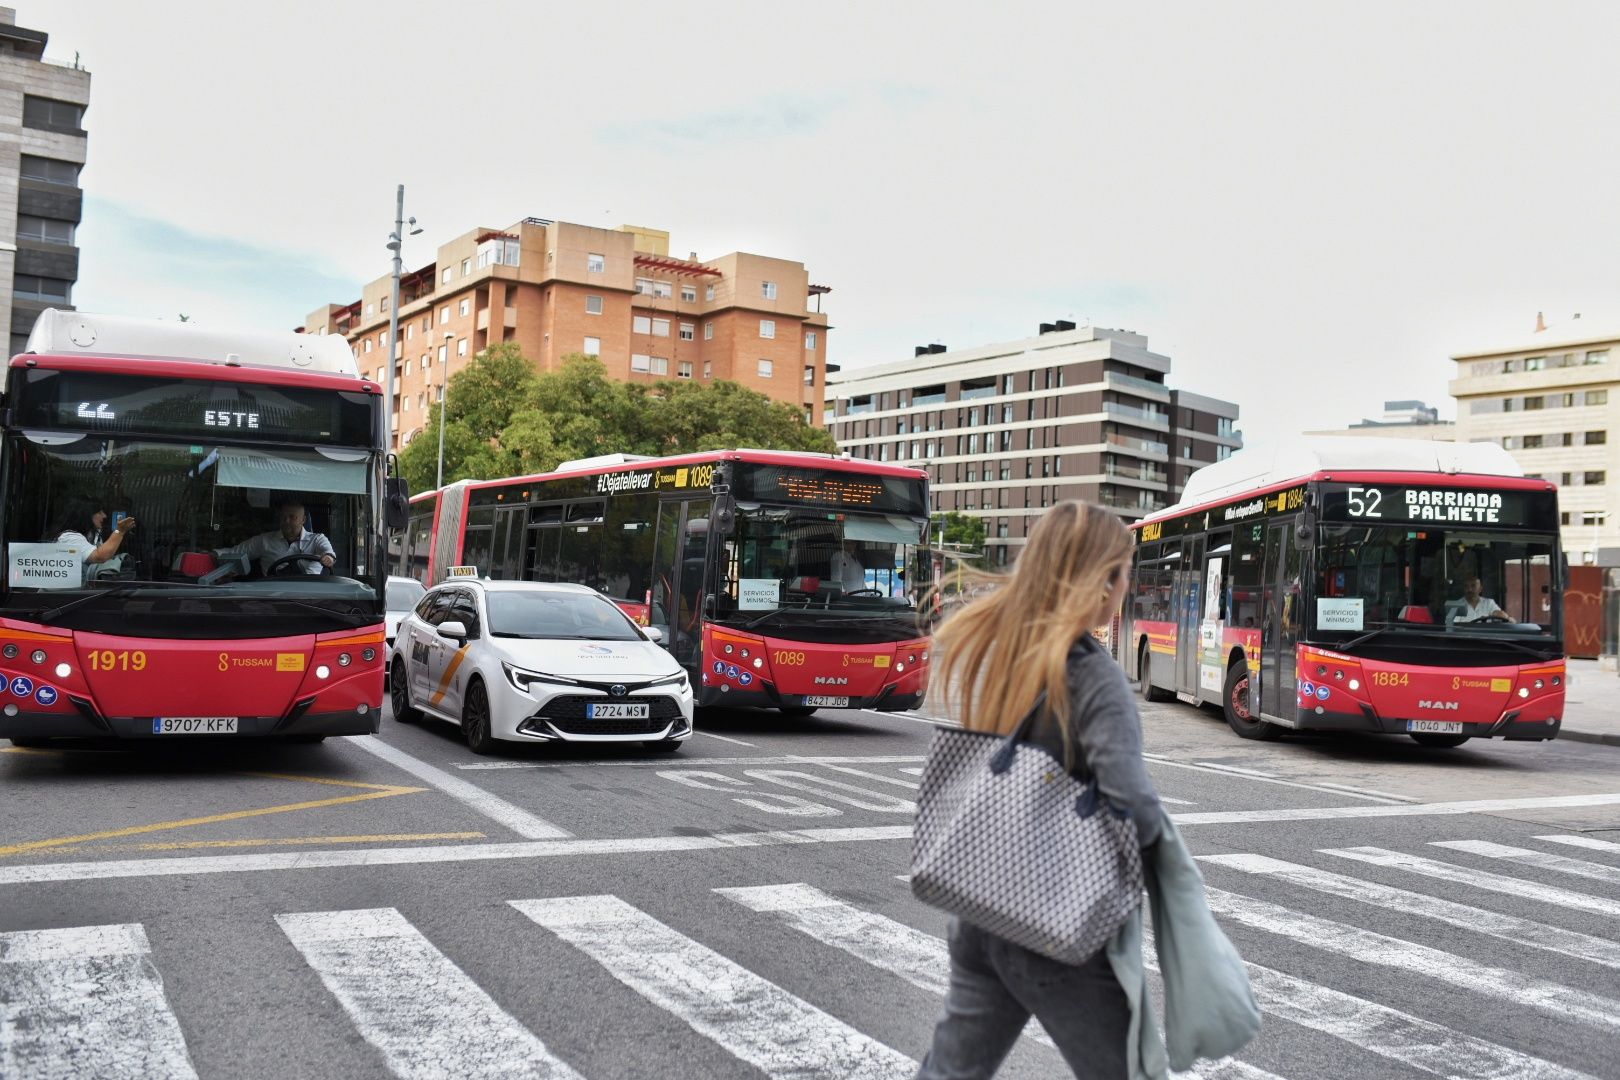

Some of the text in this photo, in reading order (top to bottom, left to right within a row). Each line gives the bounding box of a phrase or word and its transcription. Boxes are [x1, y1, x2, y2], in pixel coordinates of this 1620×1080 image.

[204, 410, 260, 429] ESTE
[690, 465, 713, 488] 1089
[1348, 487, 1382, 518] 52
[1405, 489, 1502, 508] BARRIADA
[1408, 505, 1499, 523] PALMETE
[1141, 522, 1162, 543] SEVILLA
[17, 558, 74, 568] SERVICIOS
[22, 567, 68, 578] MÍNIMOS
[1322, 609, 1359, 617] SERVICIOS
[87, 650, 147, 671] 1919
[232, 658, 273, 667] TUSSAM
[773, 650, 805, 666] 1089
[814, 676, 848, 685] MAN
[1371, 671, 1410, 687] 1884
[1462, 680, 1490, 688] TUSSAM
[807, 696, 828, 706] 8421
[1418, 699, 1460, 710] MAN
[594, 705, 647, 718] 2724 MSW
[163, 718, 236, 732] 9707 KFK
[1414, 721, 1461, 732] 1040 JNT
